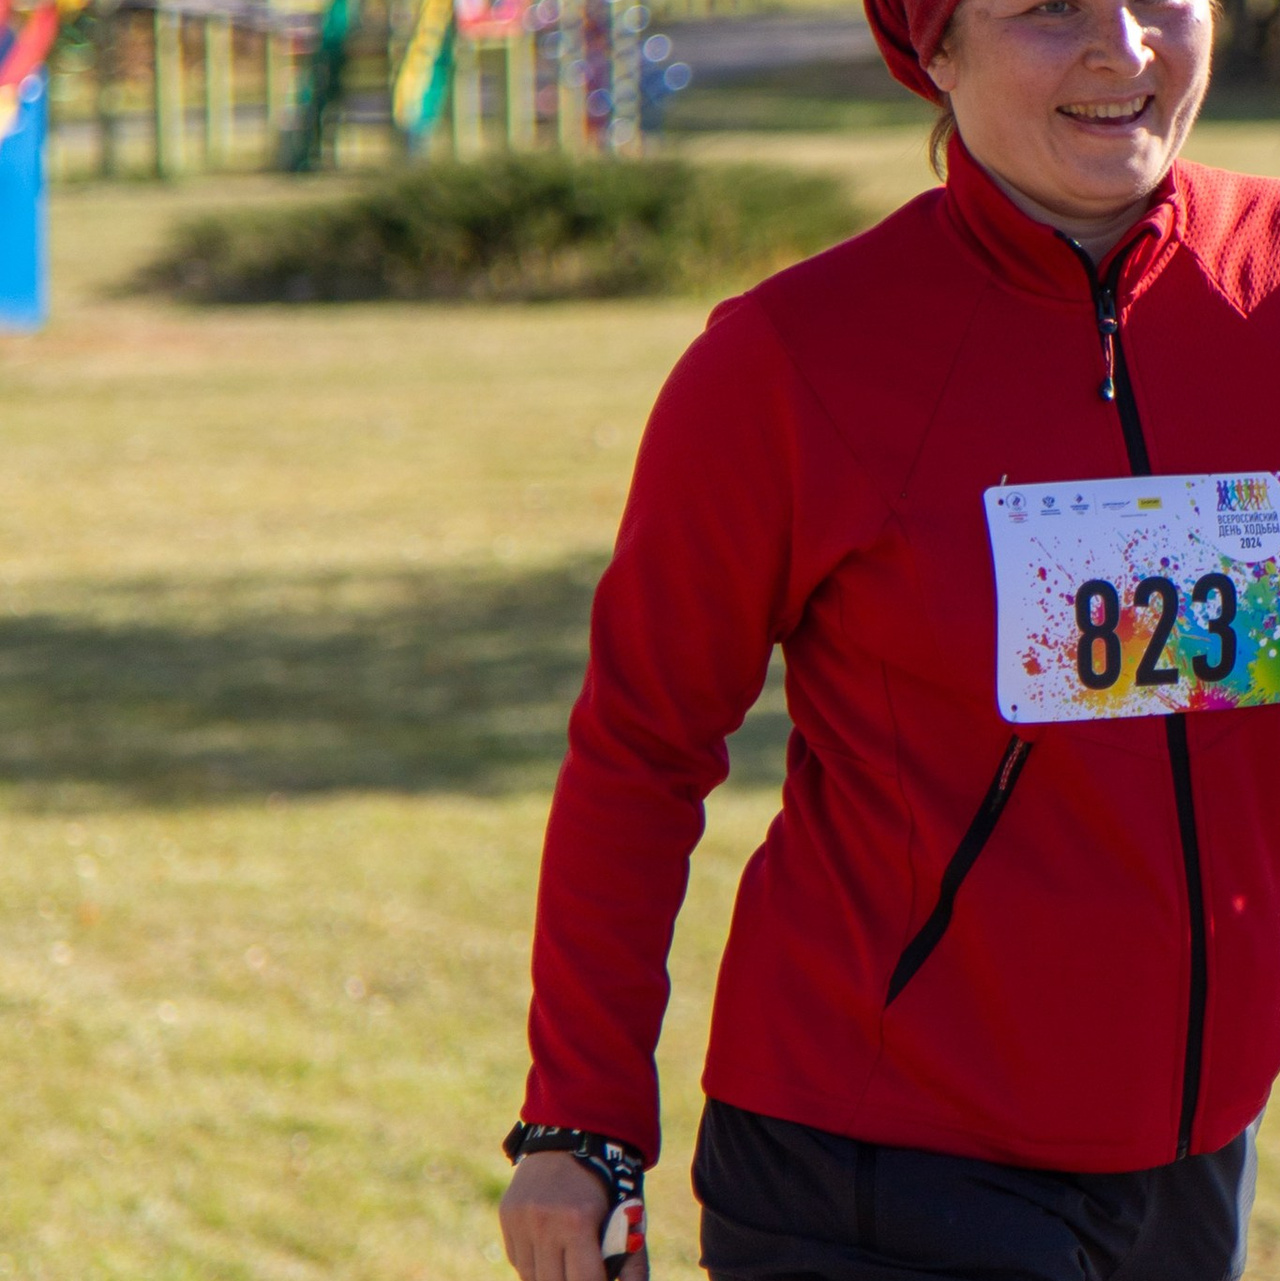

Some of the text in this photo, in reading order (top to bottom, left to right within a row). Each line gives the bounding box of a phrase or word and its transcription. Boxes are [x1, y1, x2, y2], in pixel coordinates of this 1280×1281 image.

[1217, 511, 1279, 524] ВСЕРОССИЙСКИЙ
[1219, 523, 1280, 538] ДЕНЬ ХОДЬБЫ
[1240, 537, 1262, 549] 2024
[1075, 572, 1237, 690] 823
